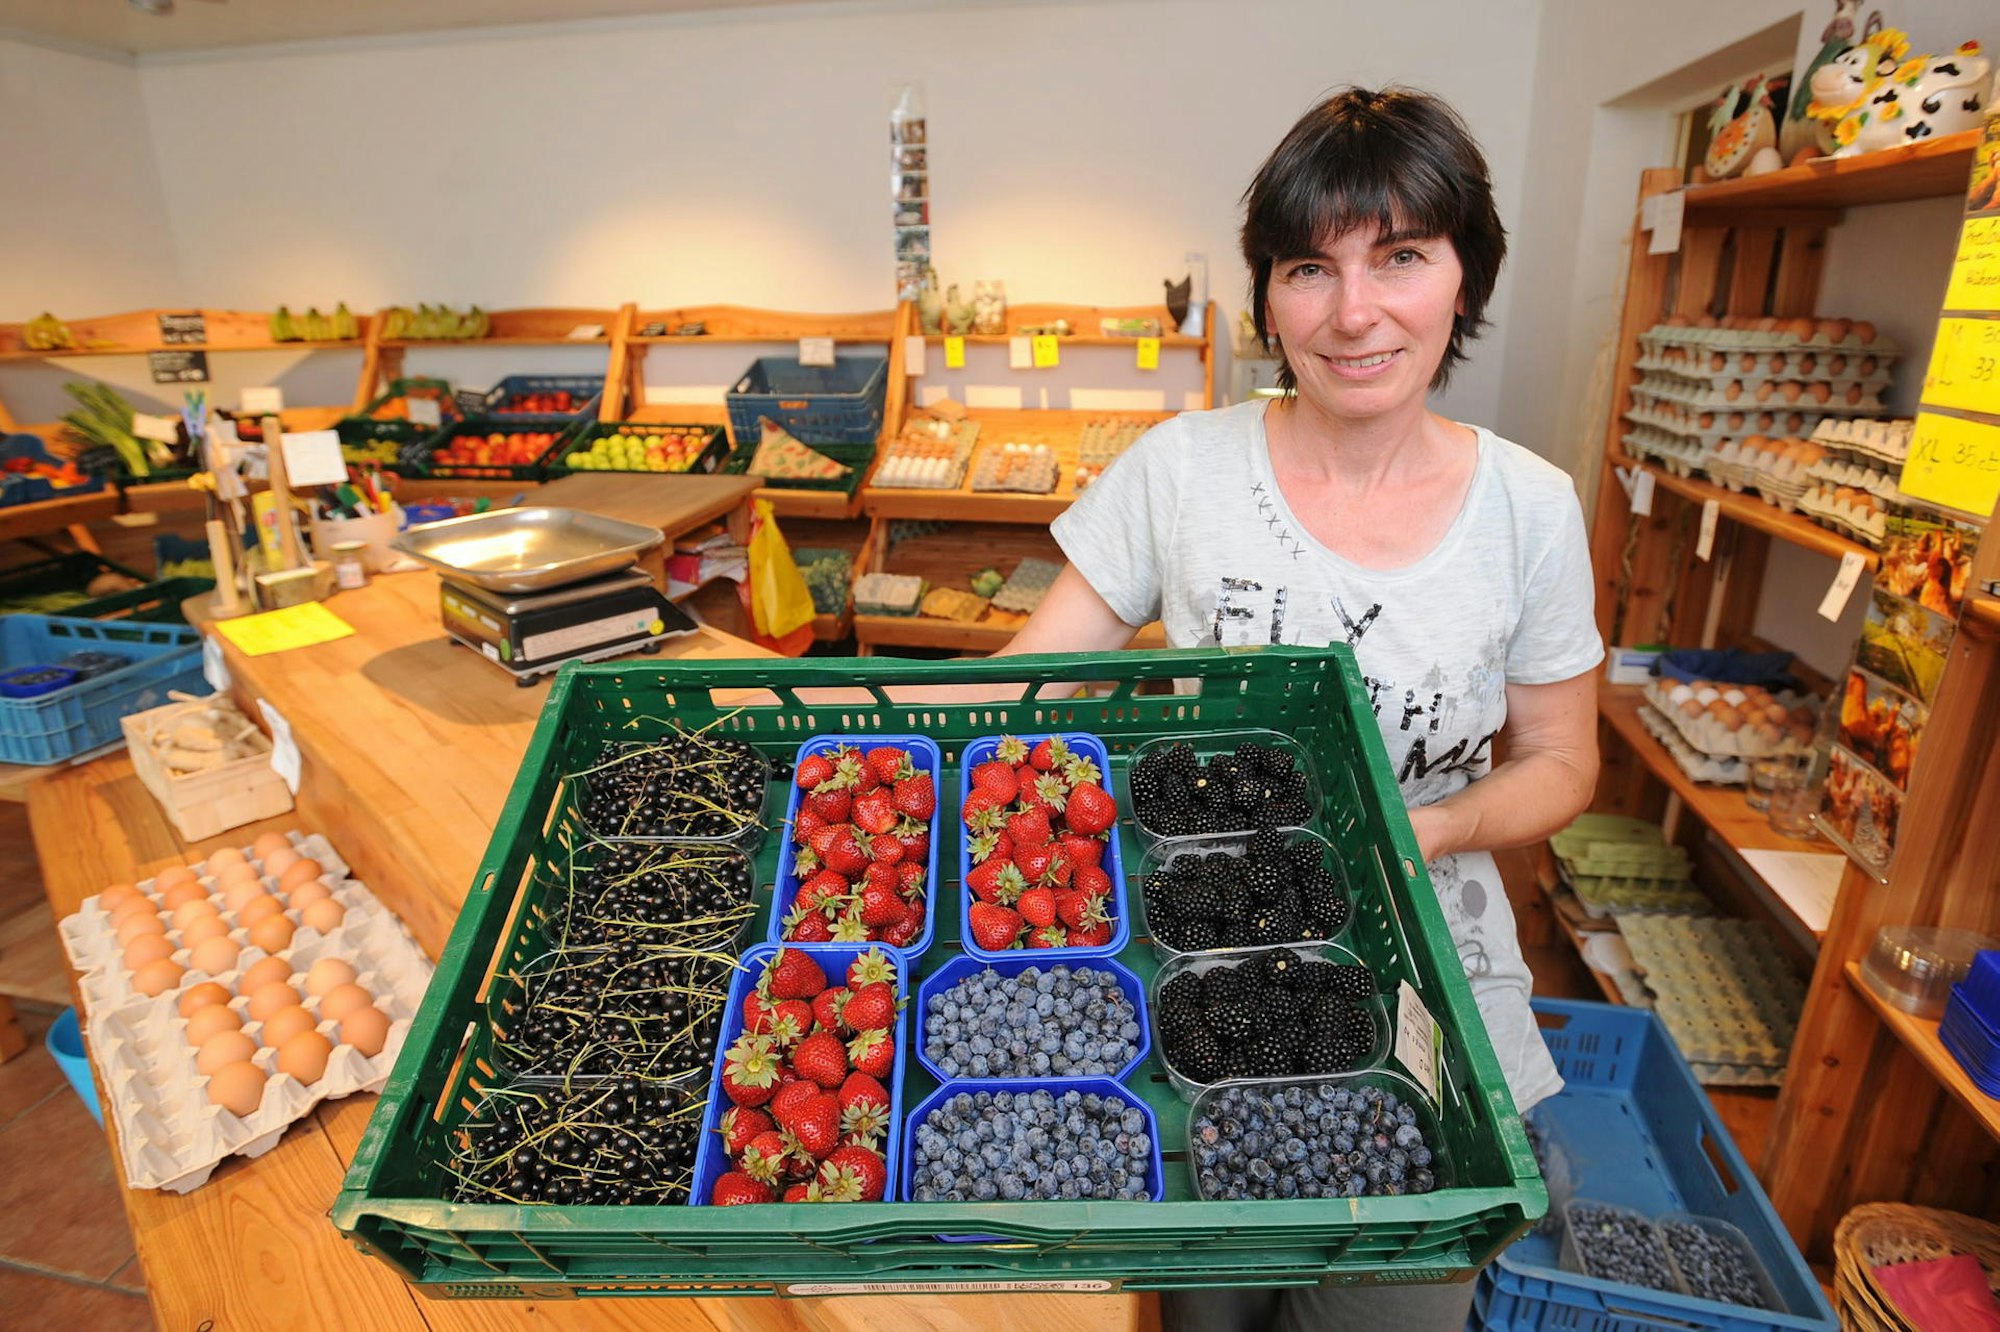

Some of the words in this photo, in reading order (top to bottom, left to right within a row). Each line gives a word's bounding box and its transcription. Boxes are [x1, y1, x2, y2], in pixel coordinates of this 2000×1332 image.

[1969, 356, 1996, 382] 33
[1914, 437, 1941, 463] XL
[1363, 676, 1442, 735] TH
